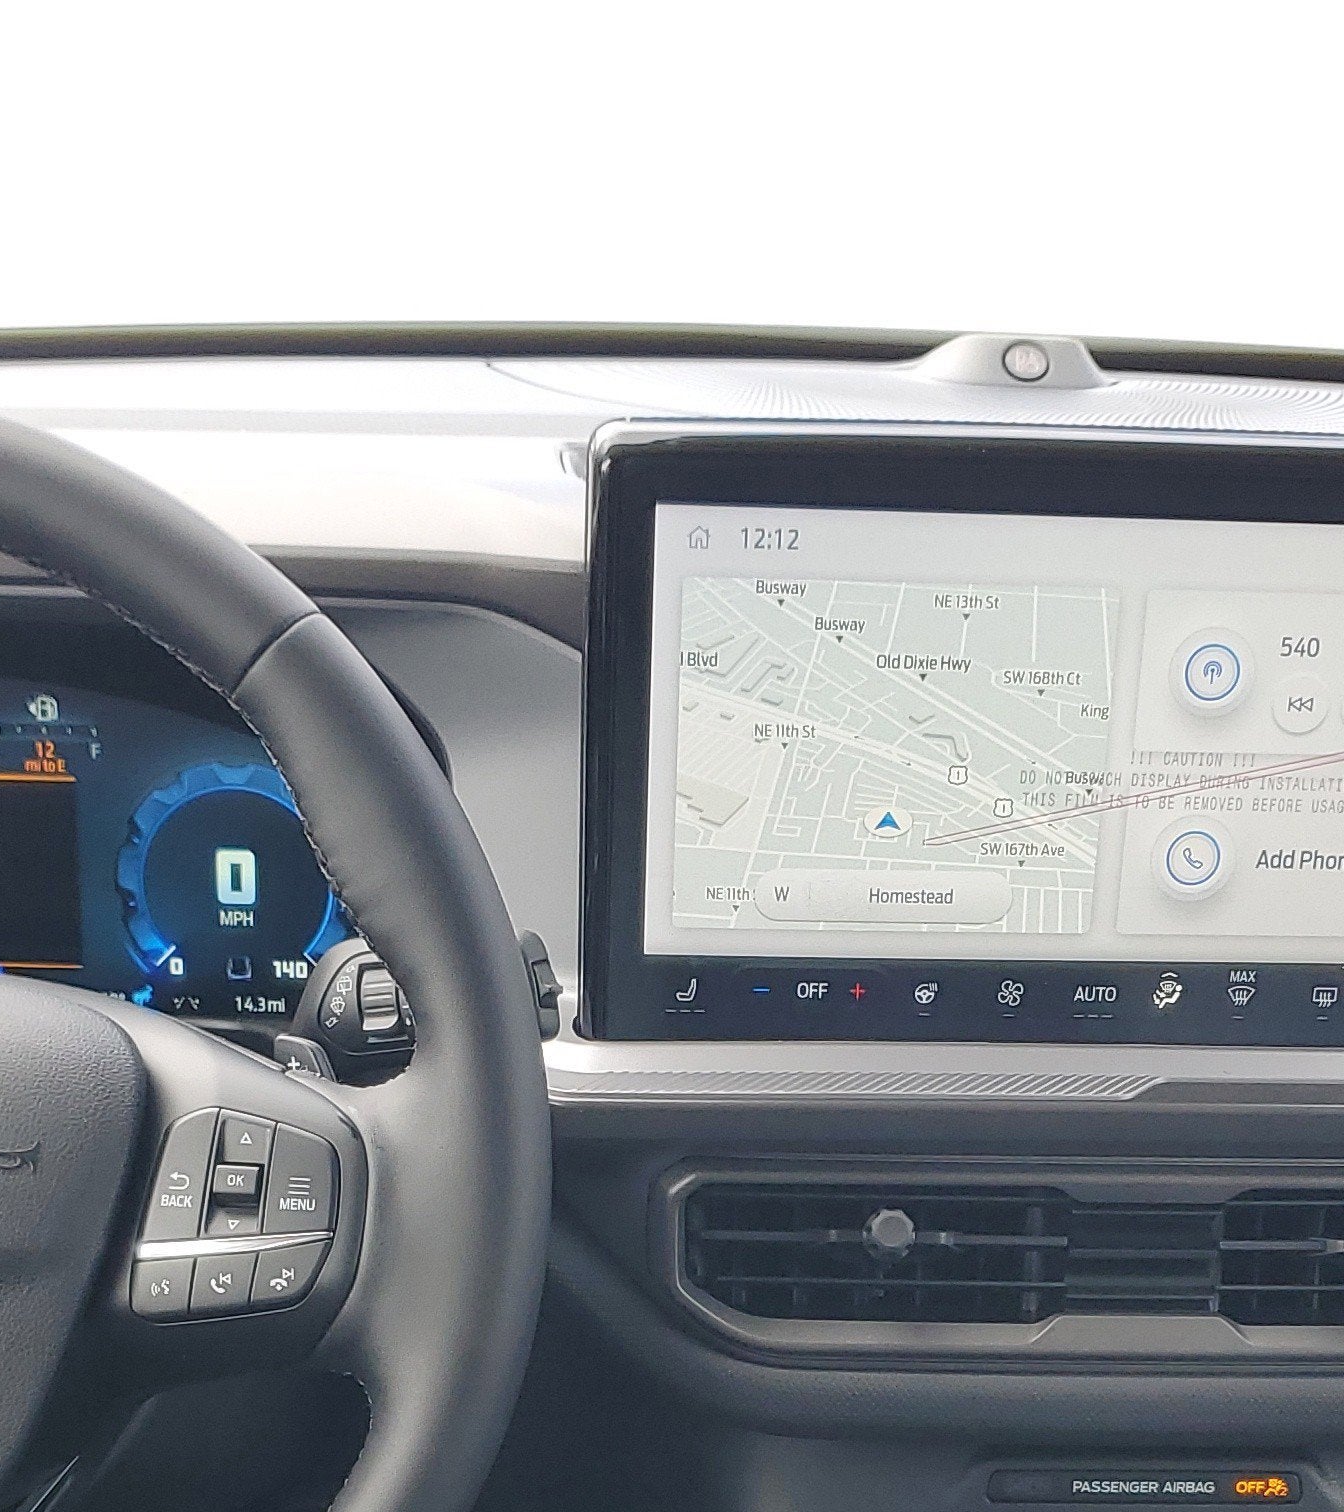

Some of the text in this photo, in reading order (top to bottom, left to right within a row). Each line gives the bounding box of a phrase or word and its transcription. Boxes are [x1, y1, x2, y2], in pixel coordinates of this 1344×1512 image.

[740, 527, 800, 551] 12:12
[755, 580, 807, 598] Busway
[934, 595, 1000, 610] NE 13th St
[814, 617, 866, 634] Busway
[1280, 637, 1321, 659] 540
[687, 652, 718, 667] Blvd
[876, 654, 972, 675] Old Dixie Hwy
[1003, 671, 1081, 685] SW 168th Ct
[1080, 704, 1110, 720] King
[754, 724, 816, 739] NE 11th St
[34, 740, 55, 758] 12
[1162, 751, 1223, 767] CAUTION
[1019, 769, 1036, 785] DO
[1130, 772, 1191, 787] DISPLAY
[1022, 792, 1056, 807] THIS
[1158, 796, 1175, 810] BE
[1183, 796, 1243, 812] REMOVED
[1252, 798, 1303, 813] BEFORE
[980, 843, 1065, 858] SW 167th Ave
[1256, 849, 1295, 870] Add
[214, 847, 257, 906] 0
[706, 887, 723, 900] NE
[774, 886, 790, 901] W
[868, 888, 954, 905] Homestead
[219, 910, 255, 928] MPH
[169, 958, 185, 976] 0
[273, 961, 308, 979] 140
[1229, 970, 1257, 983] MAX
[796, 982, 829, 999] OFF
[1073, 985, 1117, 1002] AUTO
[226, 1175, 245, 1187] OK
[160, 1194, 194, 1208] BACK
[278, 1198, 316, 1212] MENU
[1072, 1480, 1266, 1494] PASSENGER AIRBAG OFF
